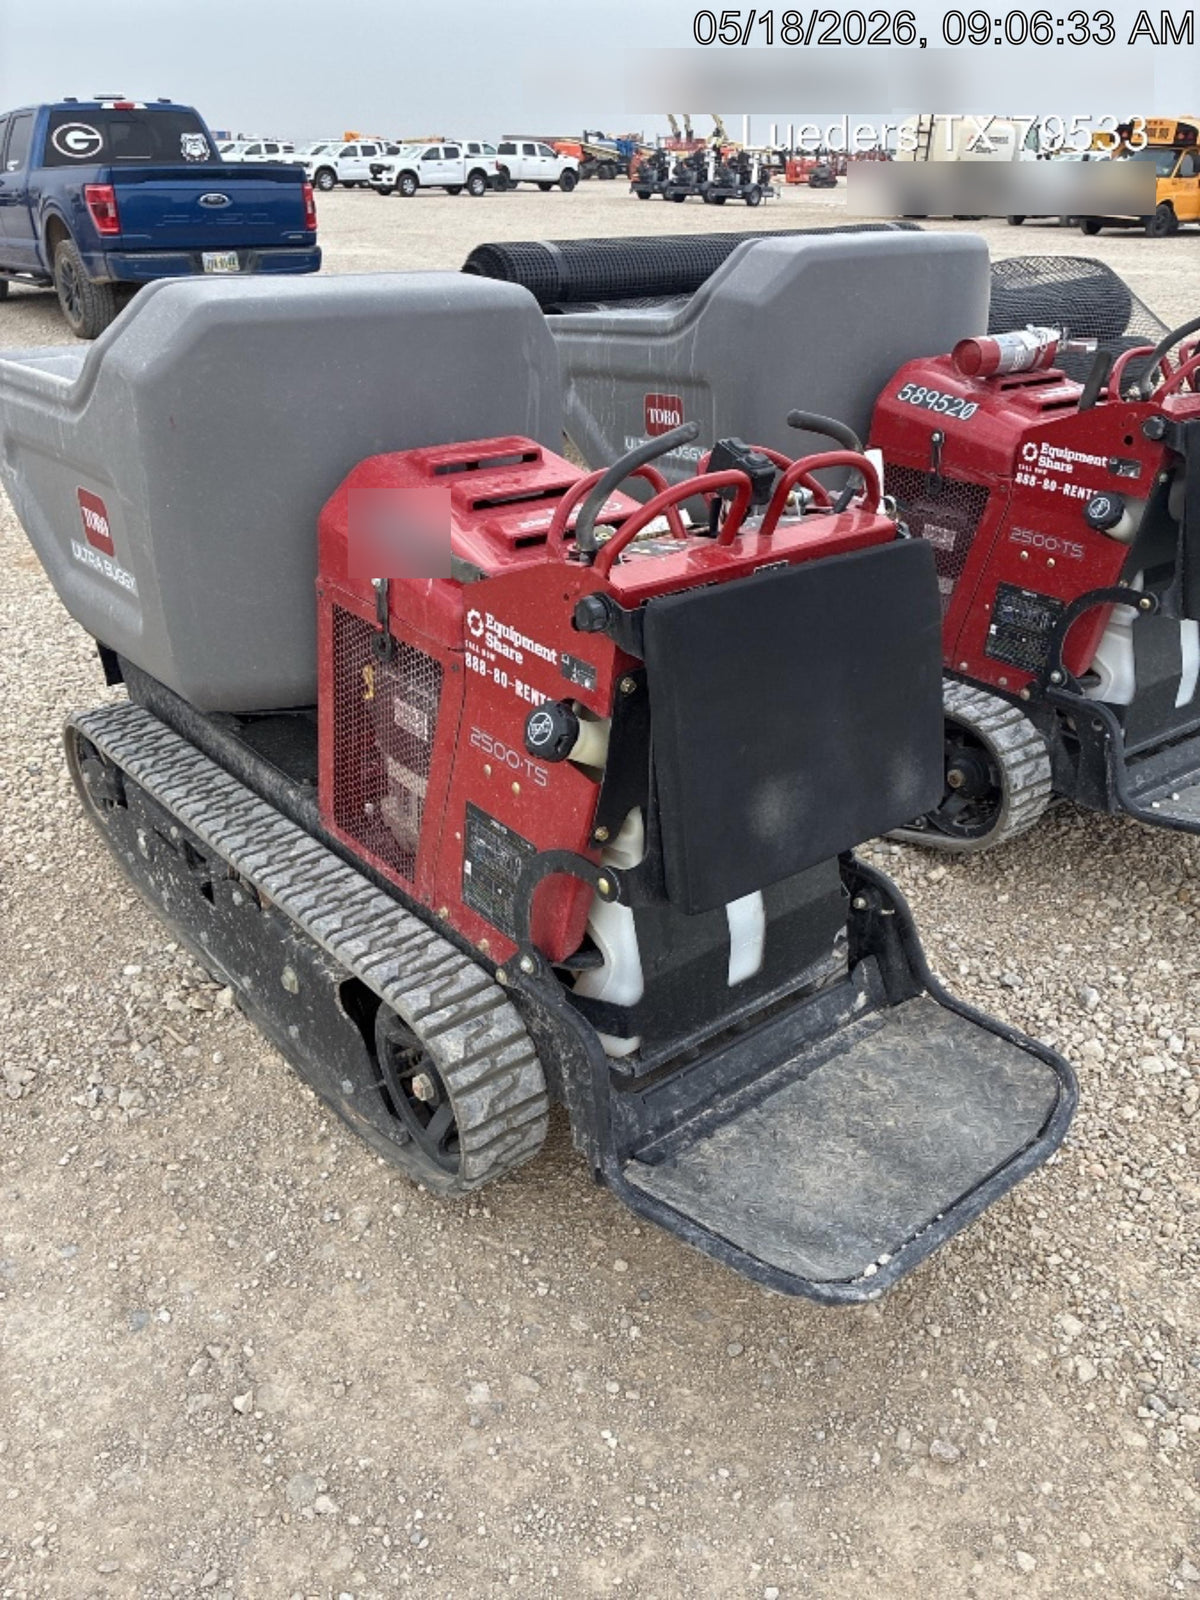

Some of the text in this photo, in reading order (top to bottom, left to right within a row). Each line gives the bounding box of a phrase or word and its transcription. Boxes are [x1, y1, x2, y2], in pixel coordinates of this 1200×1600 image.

[647, 408, 680, 426] TORO
[897, 383, 980, 420] 589520
[1038, 456, 1073, 473] Share
[1040, 442, 1108, 467] Equipment
[485, 612, 558, 666] Equipment
[485, 632, 523, 665] Share
[464, 652, 553, 706] 888-80-RENT
